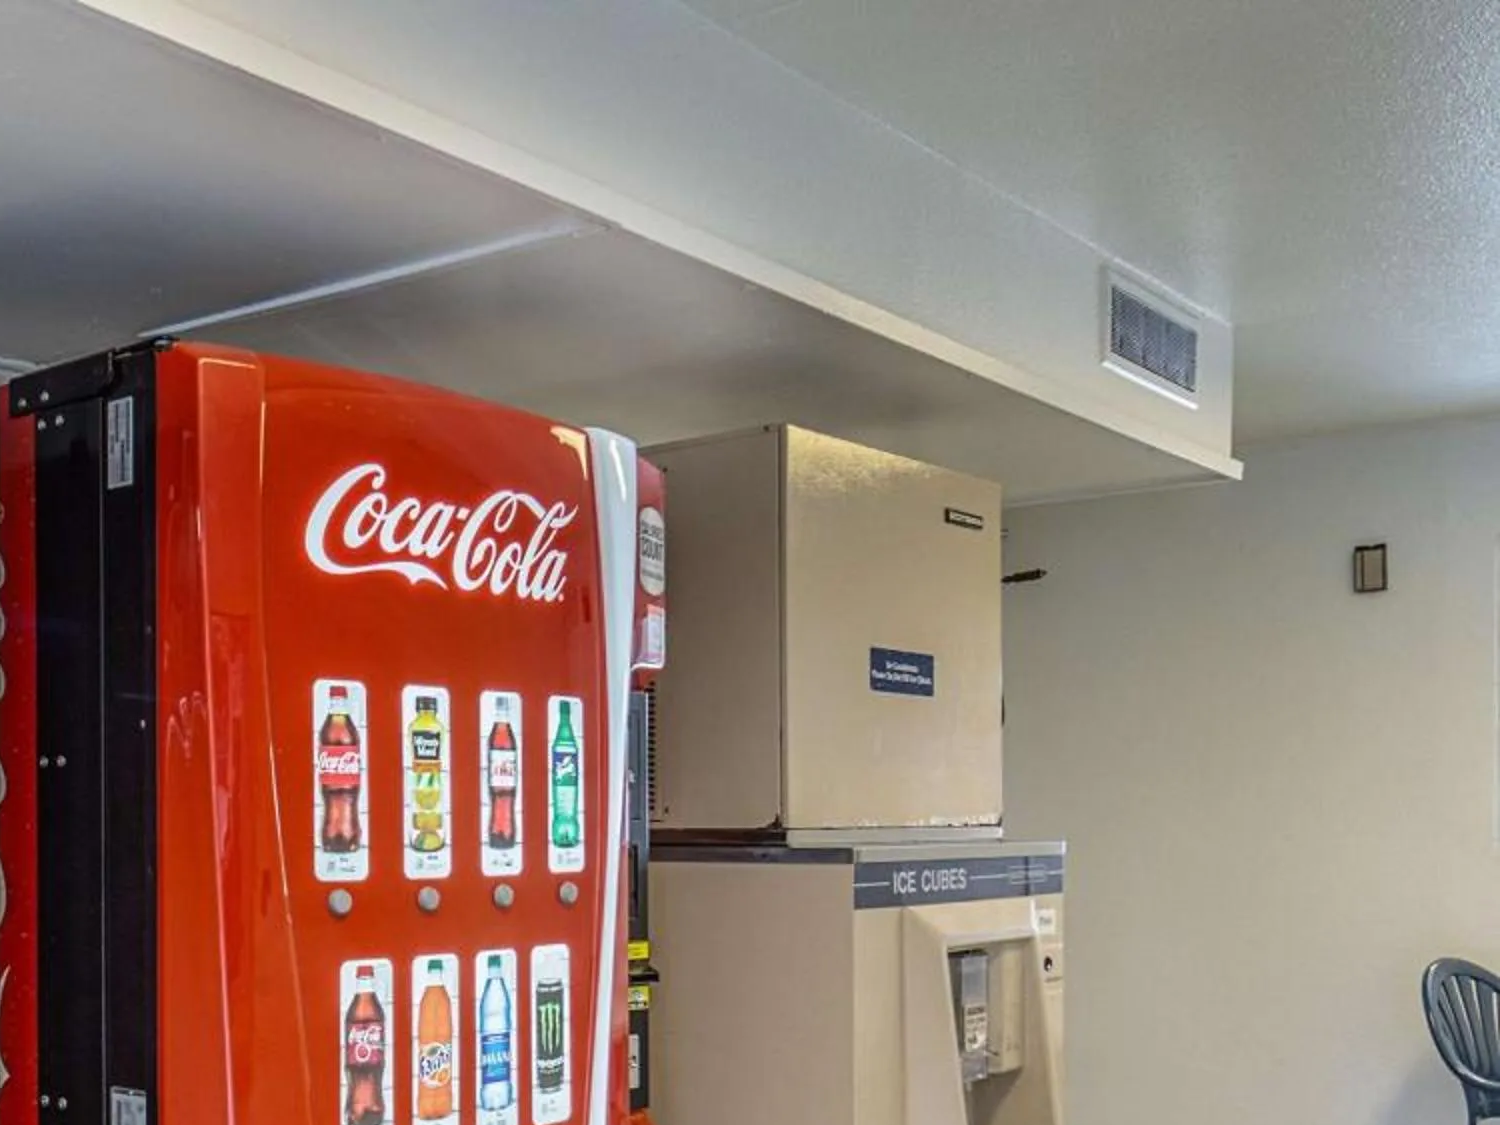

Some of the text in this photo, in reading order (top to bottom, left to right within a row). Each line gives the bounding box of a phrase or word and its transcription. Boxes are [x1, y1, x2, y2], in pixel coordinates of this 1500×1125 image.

[304, 462, 579, 602] Coca-Cola
[892, 867, 969, 895] ICE CUBES
